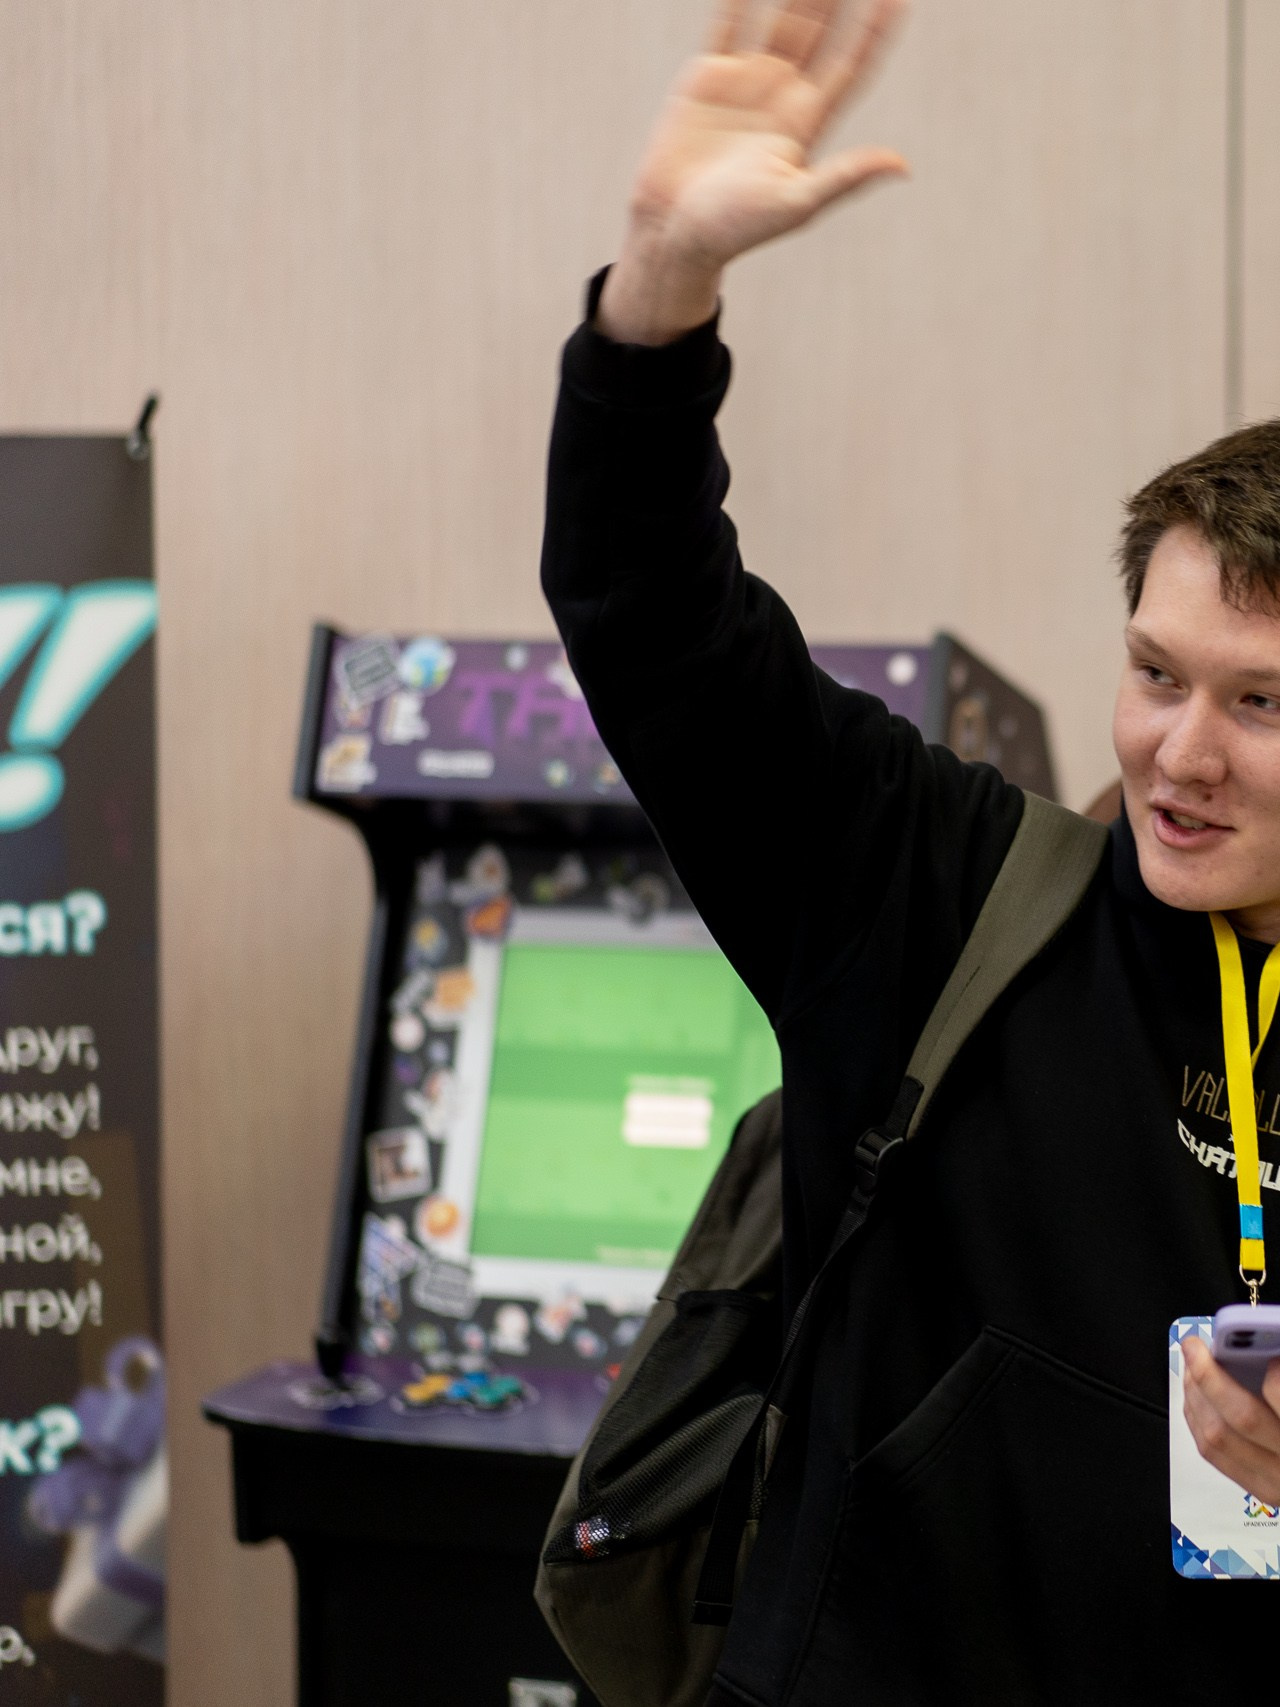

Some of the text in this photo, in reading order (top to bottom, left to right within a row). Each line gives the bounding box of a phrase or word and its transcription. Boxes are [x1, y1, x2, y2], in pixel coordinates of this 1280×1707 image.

[0, 888, 108, 957] ся?
[0, 1213, 102, 1266] ной,
[0, 1278, 102, 1336] гру!
